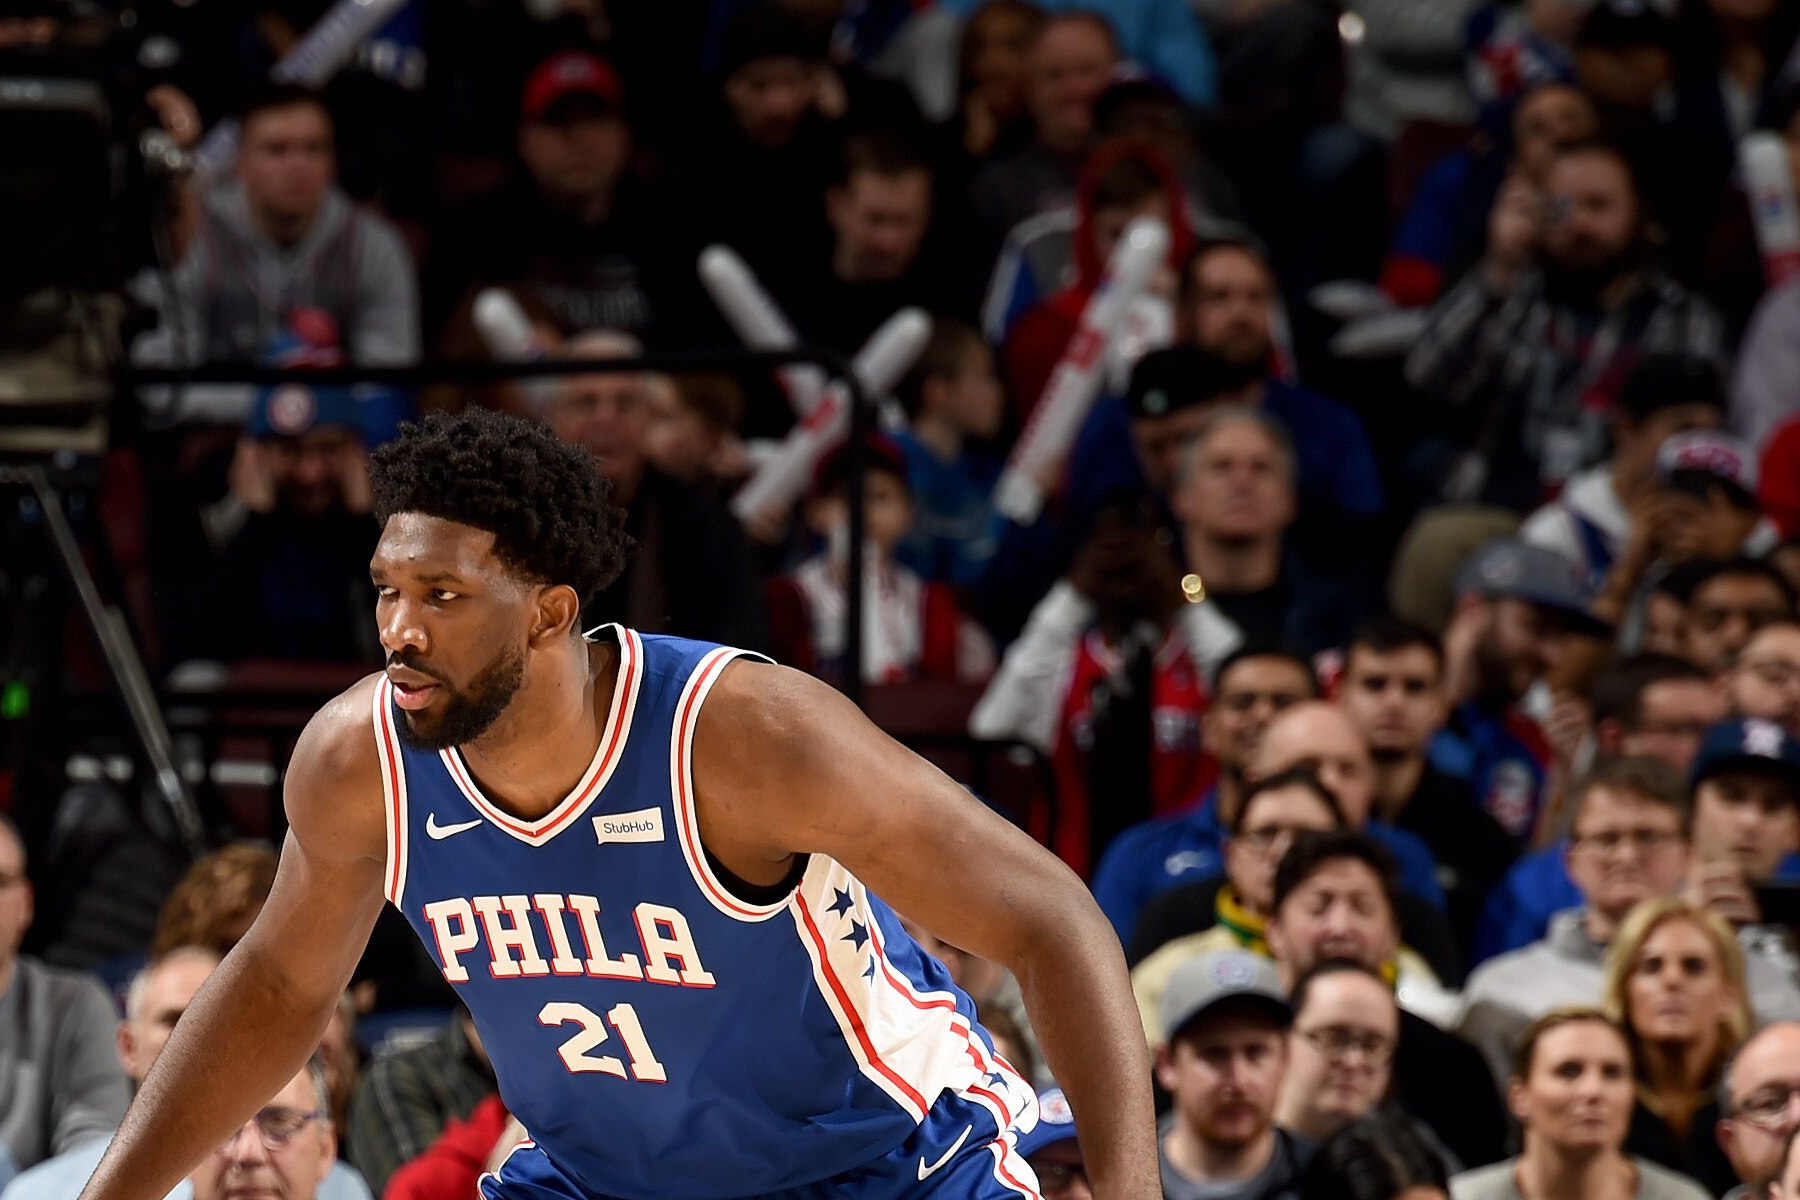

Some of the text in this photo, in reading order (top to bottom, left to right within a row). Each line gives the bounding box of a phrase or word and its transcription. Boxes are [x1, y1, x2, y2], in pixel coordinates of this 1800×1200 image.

[603, 820, 654, 835] StubHub
[422, 893, 717, 989] PHILA
[537, 1002, 667, 1084] 21
